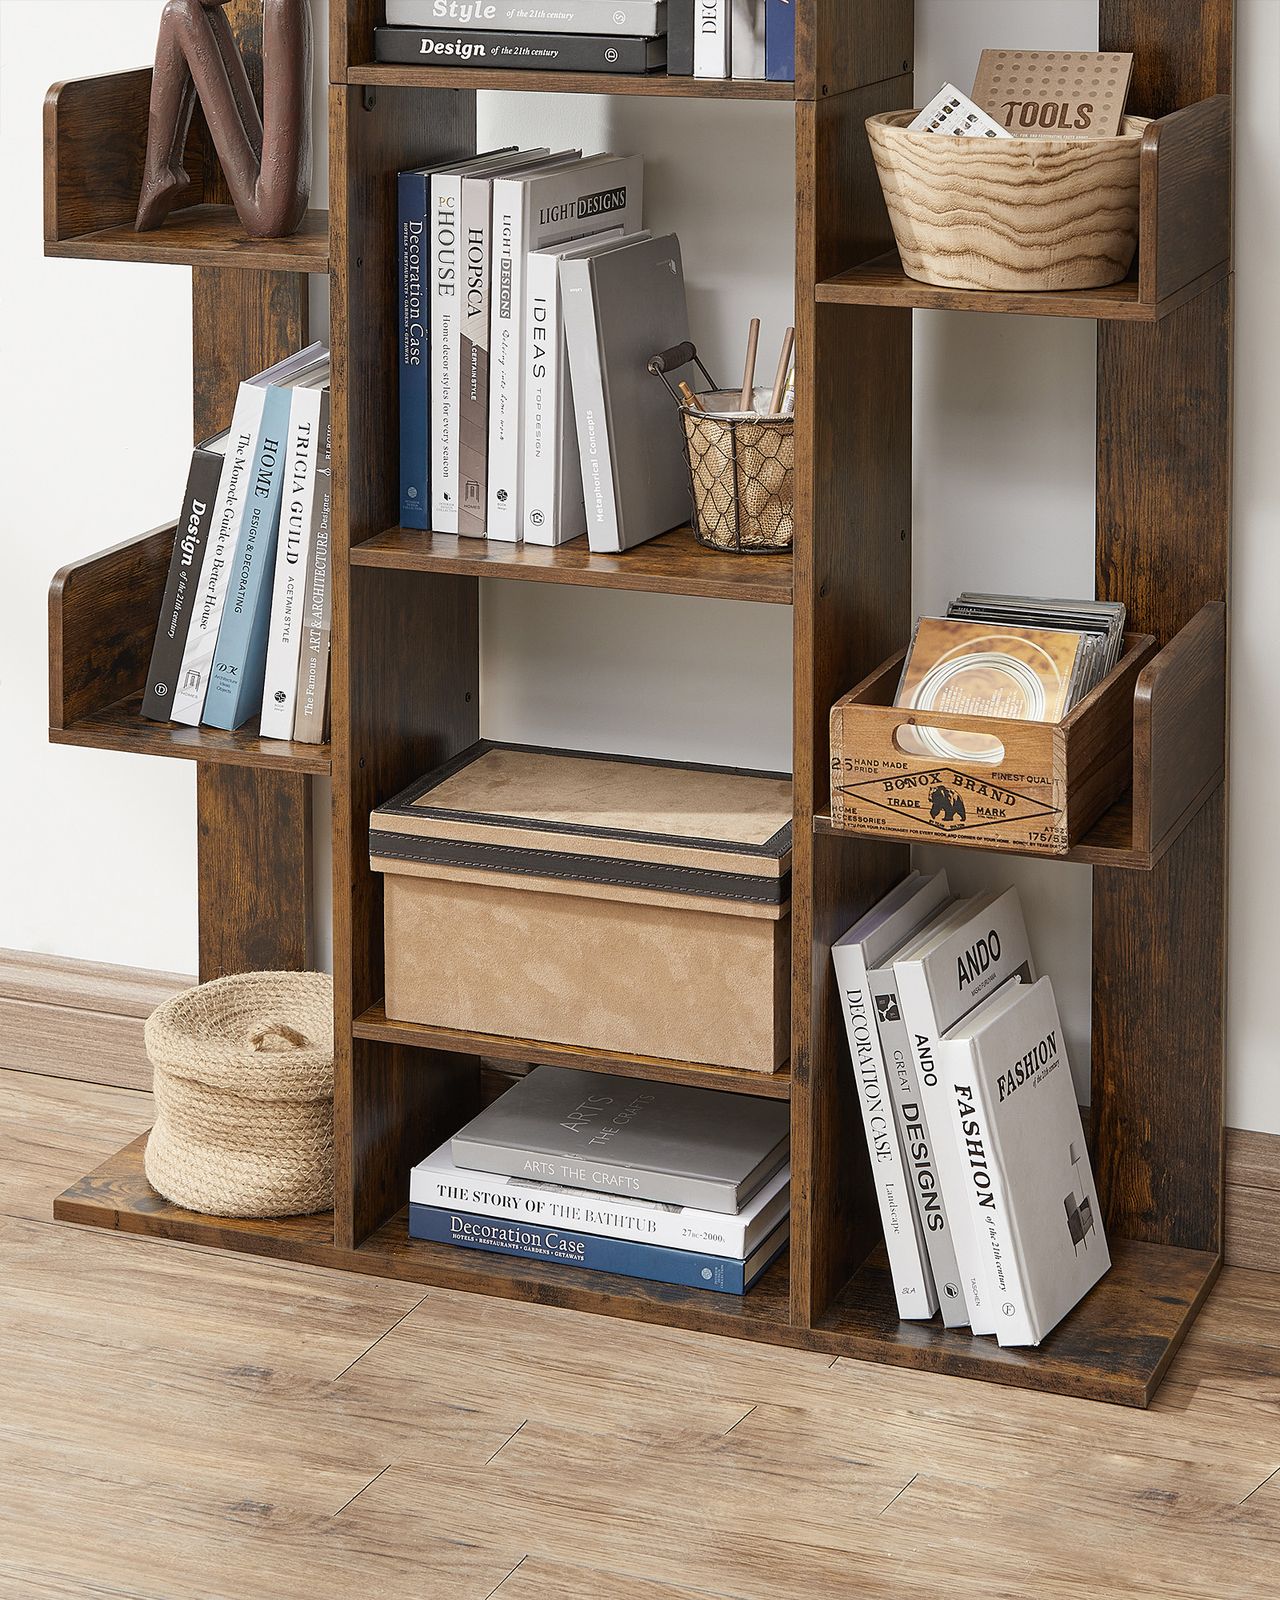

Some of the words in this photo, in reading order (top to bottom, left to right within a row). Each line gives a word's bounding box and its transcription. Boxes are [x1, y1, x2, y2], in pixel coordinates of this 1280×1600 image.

[432, 0, 496, 22] Style
[506, 9, 516, 18] of
[516, 9, 528, 18] the
[528, 10, 546, 18] 21th
[546, 11, 574, 20] century
[420, 38, 486, 59] Design
[490, 46, 500, 55] of
[501, 47, 513, 55] the
[513, 47, 530, 56] 21th
[531, 49, 558, 58] century
[1000, 101, 1094, 129] TOOLS
[439, 197, 454, 208] PC
[539, 202, 576, 225] LIGHT
[578, 189, 626, 216] DESIGNS
[502, 215, 511, 256] LIGHT
[410, 221, 423, 318] Decoration
[438, 211, 454, 296] HOUSE
[468, 228, 483, 318] HOPSCA
[501, 259, 511, 318] DESIGNS
[410, 323, 424, 366] Case
[533, 298, 546, 379] IDEAS
[441, 372, 450, 399] styles
[237, 434, 251, 455] The
[586, 410, 597, 454] Concepts
[255, 437, 279, 498] HOME
[292, 422, 310, 494] TRICIA
[226, 458, 246, 506] Monocle
[591, 459, 604, 522] Metaphorical
[219, 508, 234, 542] Guide
[248, 508, 261, 543] DESIGN
[320, 494, 329, 529] Designer
[181, 499, 206, 566] Design
[246, 544, 254, 552] &
[286, 501, 303, 565] GUILD
[216, 545, 225, 556] to
[180, 571, 187, 581] of
[208, 559, 224, 592] Better
[235, 554, 252, 614] DECORATING
[175, 594, 184, 610] 21th
[200, 594, 216, 630] House
[168, 610, 178, 638] century
[282, 617, 292, 643] STYLE
[310, 628, 321, 653] ART
[306, 658, 317, 695] Famous
[304, 697, 314, 716] The
[832, 758, 853, 770] 25
[992, 772, 1024, 782] FINEST
[883, 773, 942, 792] BONOX
[952, 774, 1016, 806] BRAND
[833, 806, 857, 814] HOME
[833, 814, 886, 825] ACCESSORIES
[888, 798, 920, 807] TRADE
[976, 807, 1006, 817] MARK
[957, 930, 1000, 991] ANDO
[894, 1050, 911, 1092] GREAT
[915, 1034, 937, 1086] ANDO
[996, 1030, 1057, 1103] FASHION
[560, 1096, 613, 1132] ARTS
[588, 1127, 620, 1144] THE
[613, 1094, 655, 1124] CRAFTS
[846, 989, 883, 1113] DECORATION
[871, 1116, 892, 1163] CASE
[885, 1183, 900, 1234] Landscape
[954, 1084, 996, 1210] FASHION
[524, 1160, 555, 1176] ARTS
[560, 1165, 586, 1181] THE
[592, 1171, 640, 1190] CRAFTS
[901, 1103, 943, 1232] DESIGNS
[437, 1184, 468, 1202] THE
[472, 1190, 522, 1210] STORY
[525, 1199, 546, 1213] OF
[549, 1203, 581, 1220] THE
[585, 1209, 657, 1233] BATHTUB
[985, 1216, 995, 1226] of
[450, 1217, 542, 1247] Decoration
[546, 1233, 585, 1254] Case
[452, 1234, 475, 1242] HOTELS
[479, 1237, 518, 1250] RESTAURANTS
[523, 1245, 550, 1255] GARDENS
[554, 1250, 585, 1261] GETAWAYS
[992, 1242, 1002, 1260] 21th
[971, 1278, 981, 1306] TASCHEN
[996, 1261, 1006, 1292] century
